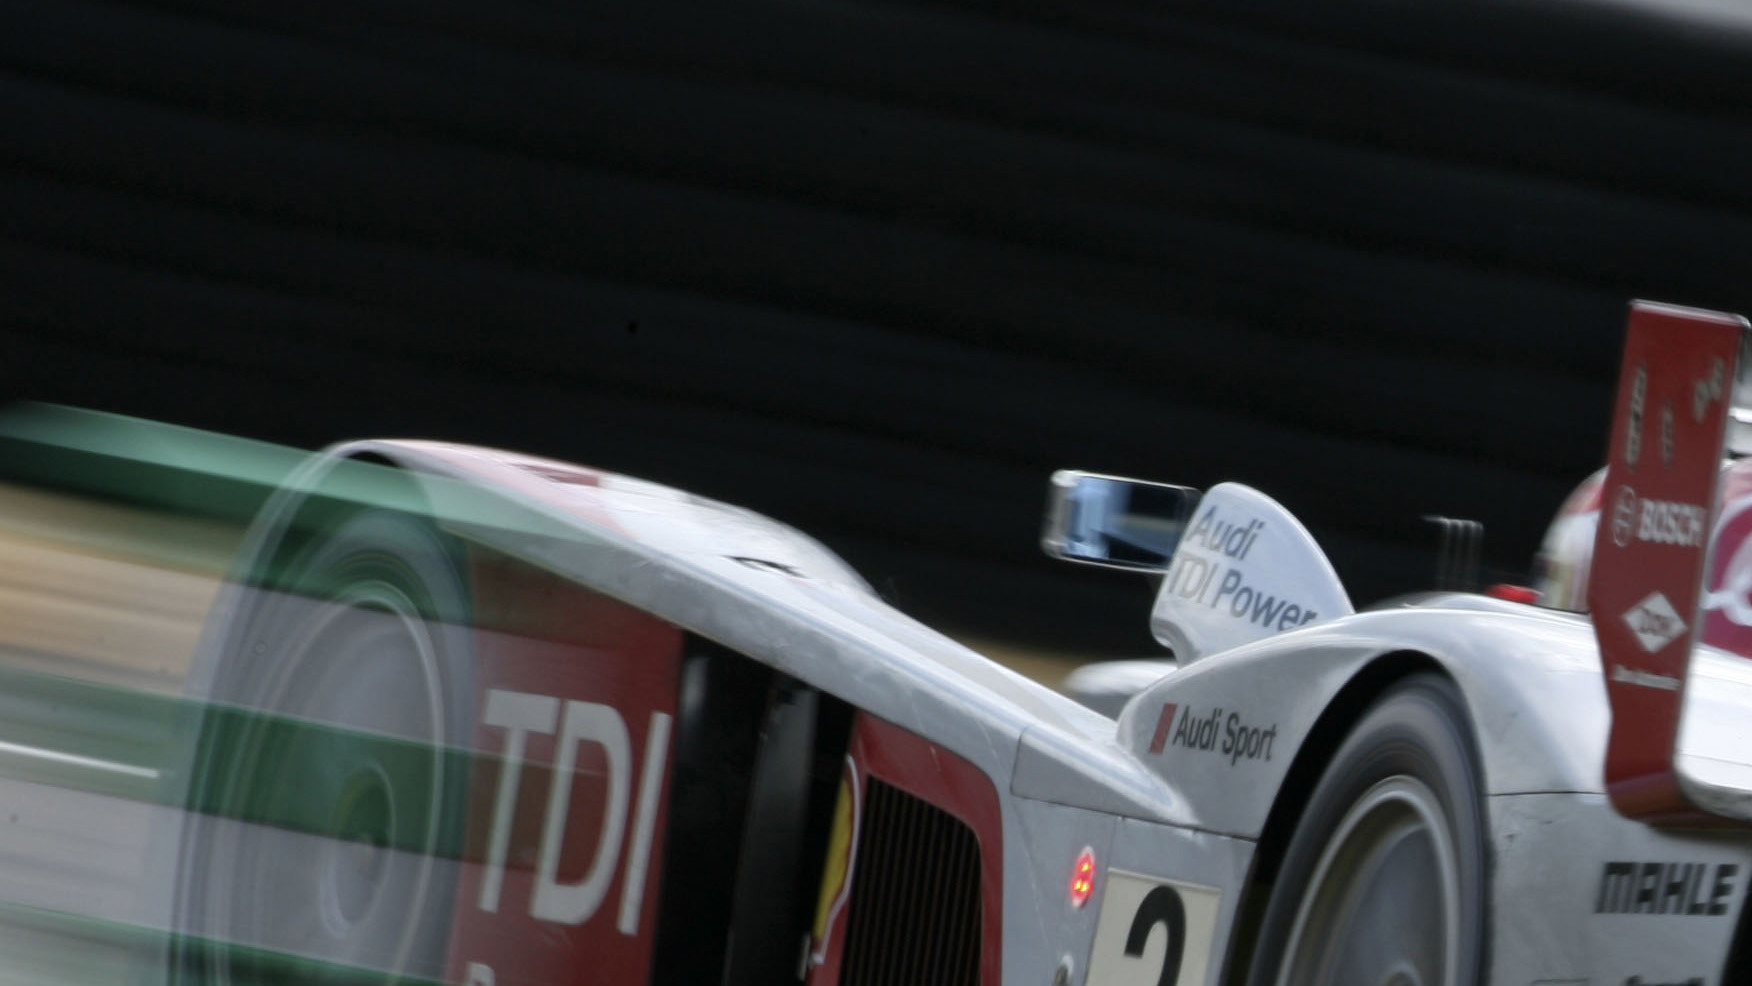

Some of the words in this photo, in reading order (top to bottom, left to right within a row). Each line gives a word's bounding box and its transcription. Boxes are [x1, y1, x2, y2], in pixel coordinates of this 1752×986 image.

[1184, 506, 1266, 562] Audi
[1637, 498, 1706, 548] BOSCH
[1168, 551, 1218, 604] TDI
[1172, 705, 1222, 752] Audi
[1222, 712, 1277, 767] Sport
[478, 689, 673, 936] TDI
[1594, 861, 1739, 916] MAHLE
